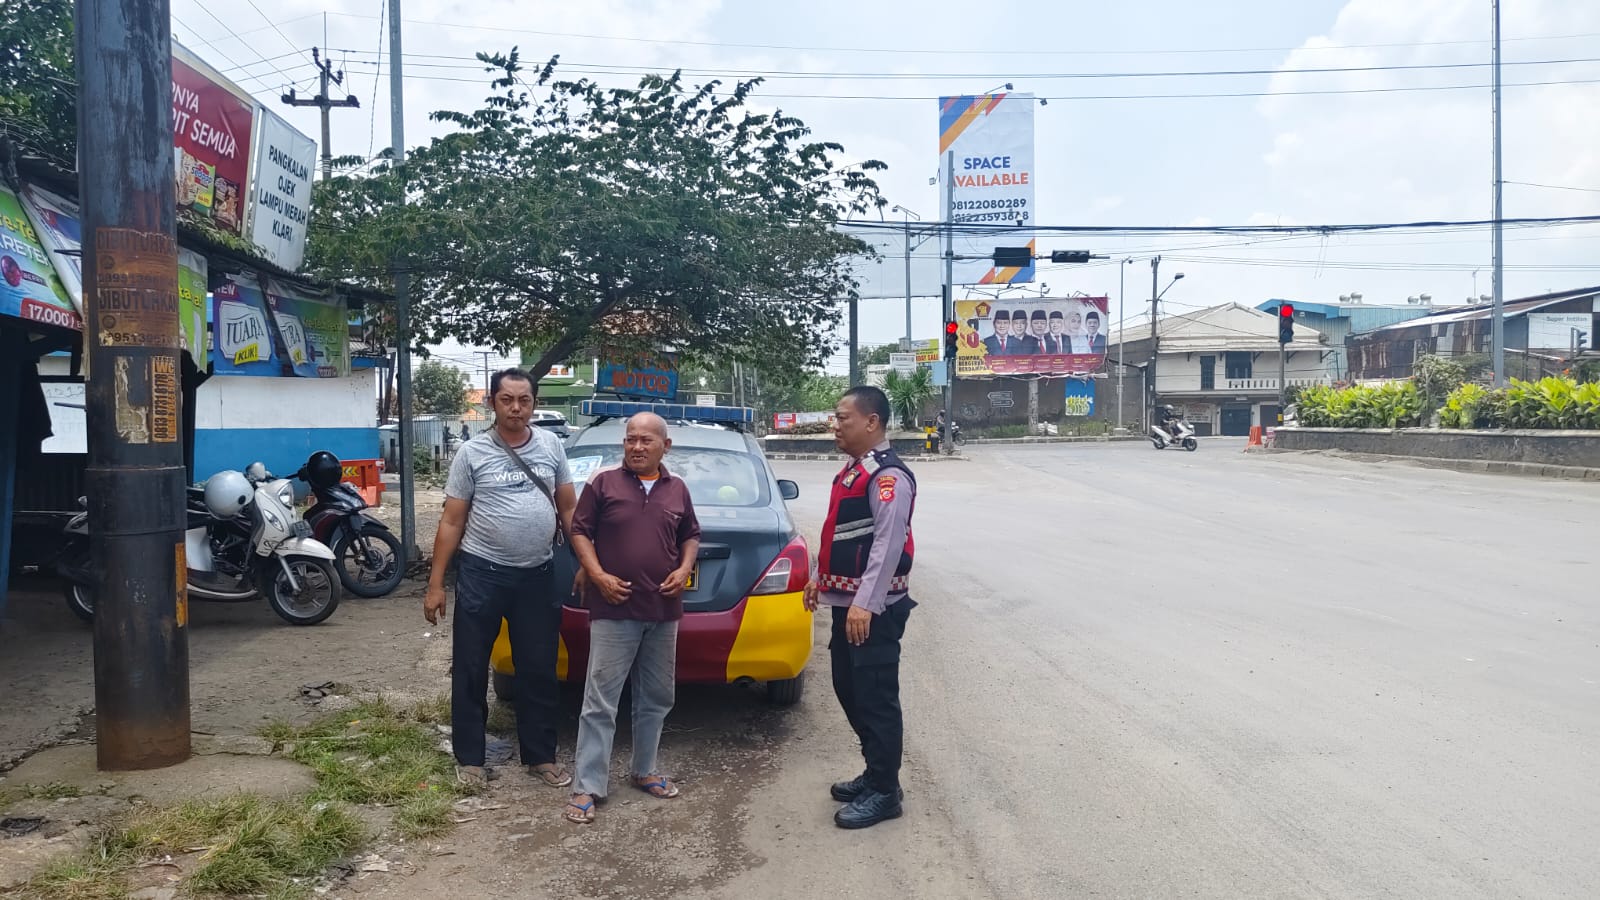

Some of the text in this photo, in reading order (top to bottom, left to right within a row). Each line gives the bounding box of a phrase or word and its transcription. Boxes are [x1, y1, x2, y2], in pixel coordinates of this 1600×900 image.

[190, 119, 236, 159] SEMUA
[269, 145, 309, 183] PANGKALAN
[964, 156, 1011, 170] SPACE
[277, 177, 296, 197] OJEK
[259, 188, 307, 227] LAMPU MERAH
[272, 219, 293, 242] KLARI
[226, 316, 264, 346] JUARA
[612, 369, 670, 394] MOTOR
[493, 466, 551, 482] Wranler
